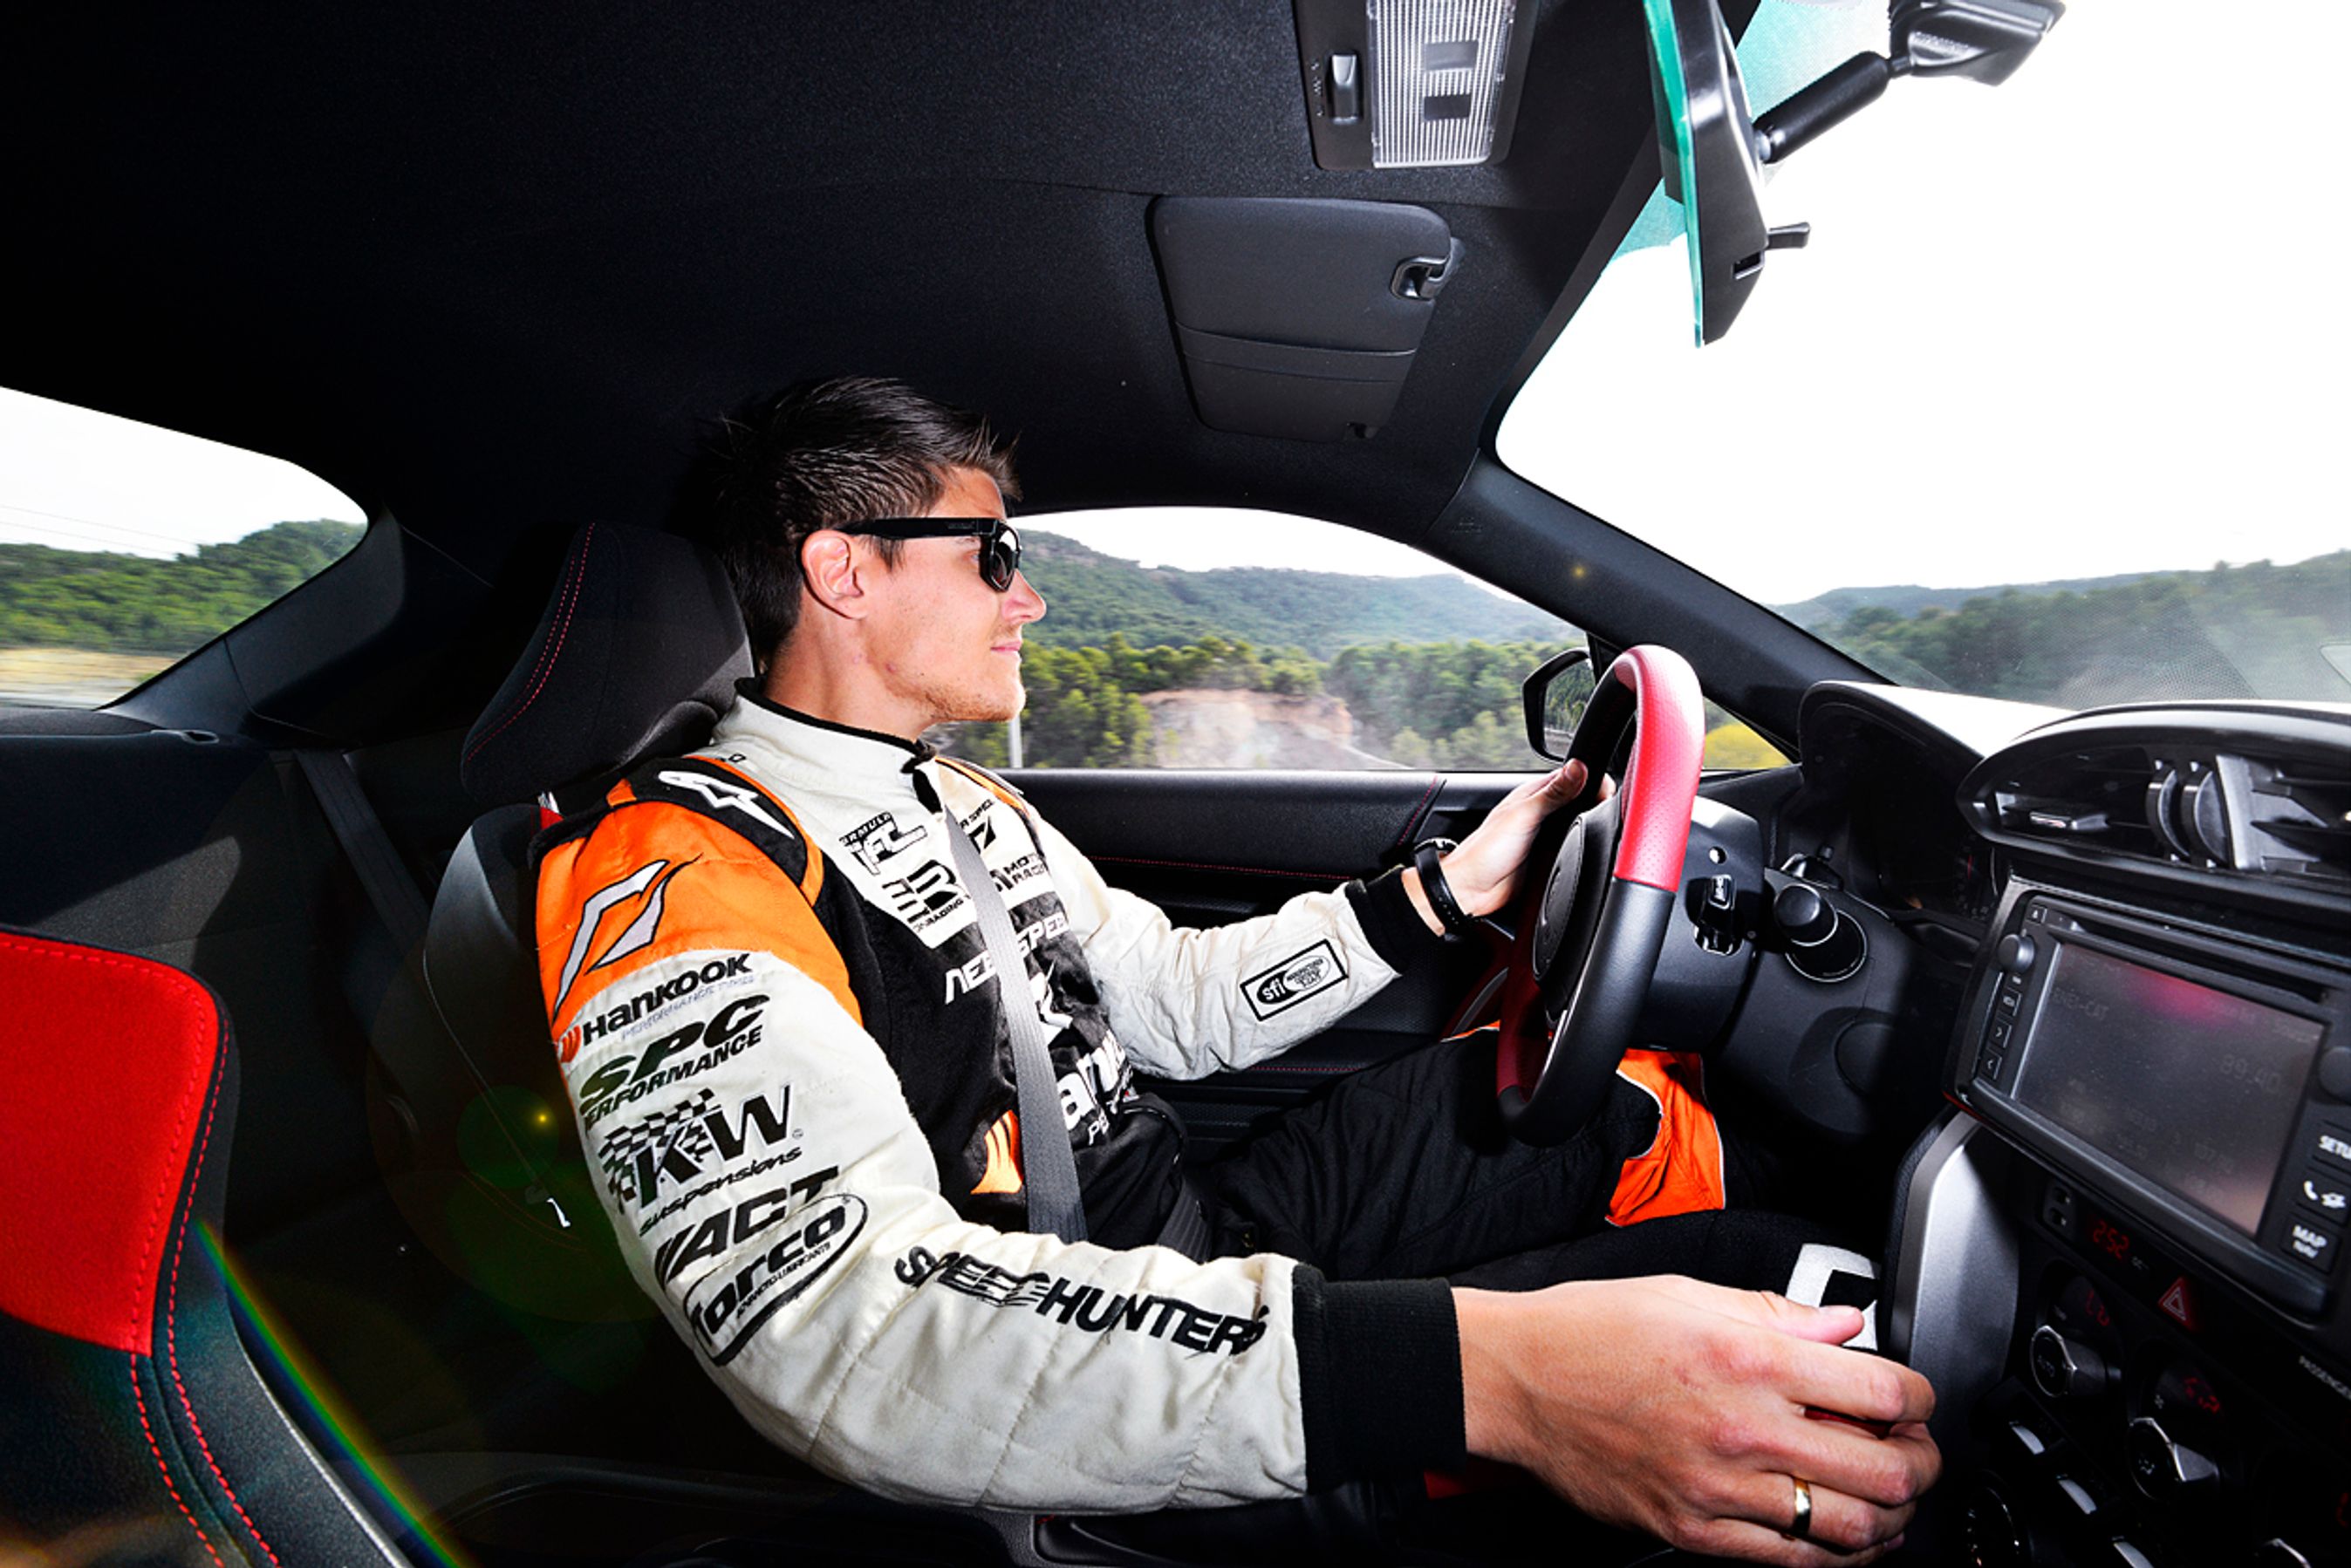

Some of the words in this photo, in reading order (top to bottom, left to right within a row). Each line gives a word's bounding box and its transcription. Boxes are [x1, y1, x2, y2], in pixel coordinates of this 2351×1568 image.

[579, 995, 770, 1099] SPC
[635, 1085, 791, 1209] KW
[894, 1245, 1271, 1358] SEEHUNTER
